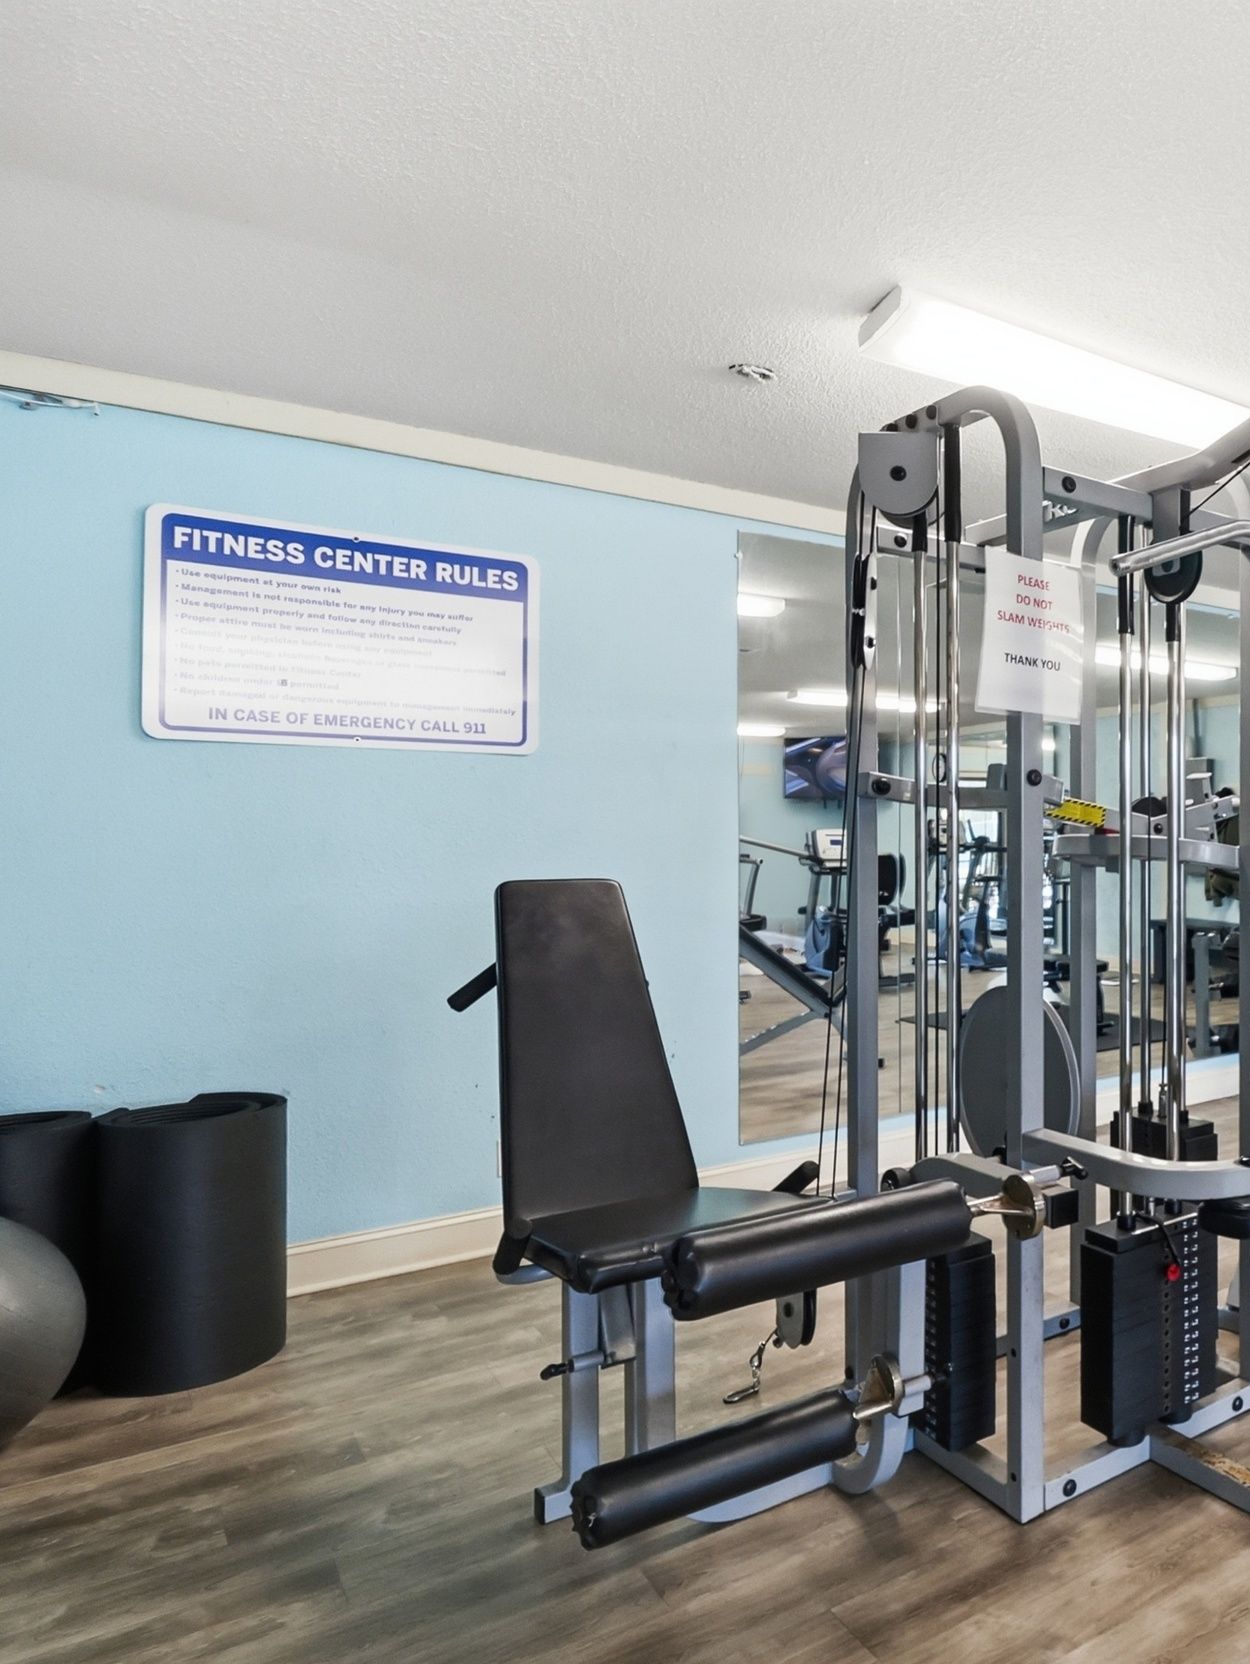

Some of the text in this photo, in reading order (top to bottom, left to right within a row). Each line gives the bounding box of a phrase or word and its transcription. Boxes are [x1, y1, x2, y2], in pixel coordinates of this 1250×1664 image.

[173, 526, 519, 591] FITNESS CENTER RULES
[181, 568, 201, 578] Use
[203, 572, 259, 585] equipment
[276, 581, 298, 589] your
[301, 584, 321, 592] own
[323, 586, 341, 594] risk
[1017, 574, 1050, 591] PLEASE
[181, 583, 249, 598] Management
[264, 593, 281, 601] not
[284, 596, 341, 608] responsible
[181, 597, 201, 607] Use
[203, 601, 259, 613] equipment
[1016, 593, 1053, 610] DO NOT
[997, 610, 1070, 634] SLAM WEIGHTS
[1004, 652, 1061, 672] THANK YOU
[208, 707, 487, 735] IN CASE OF EMERGENCY CALL 911
